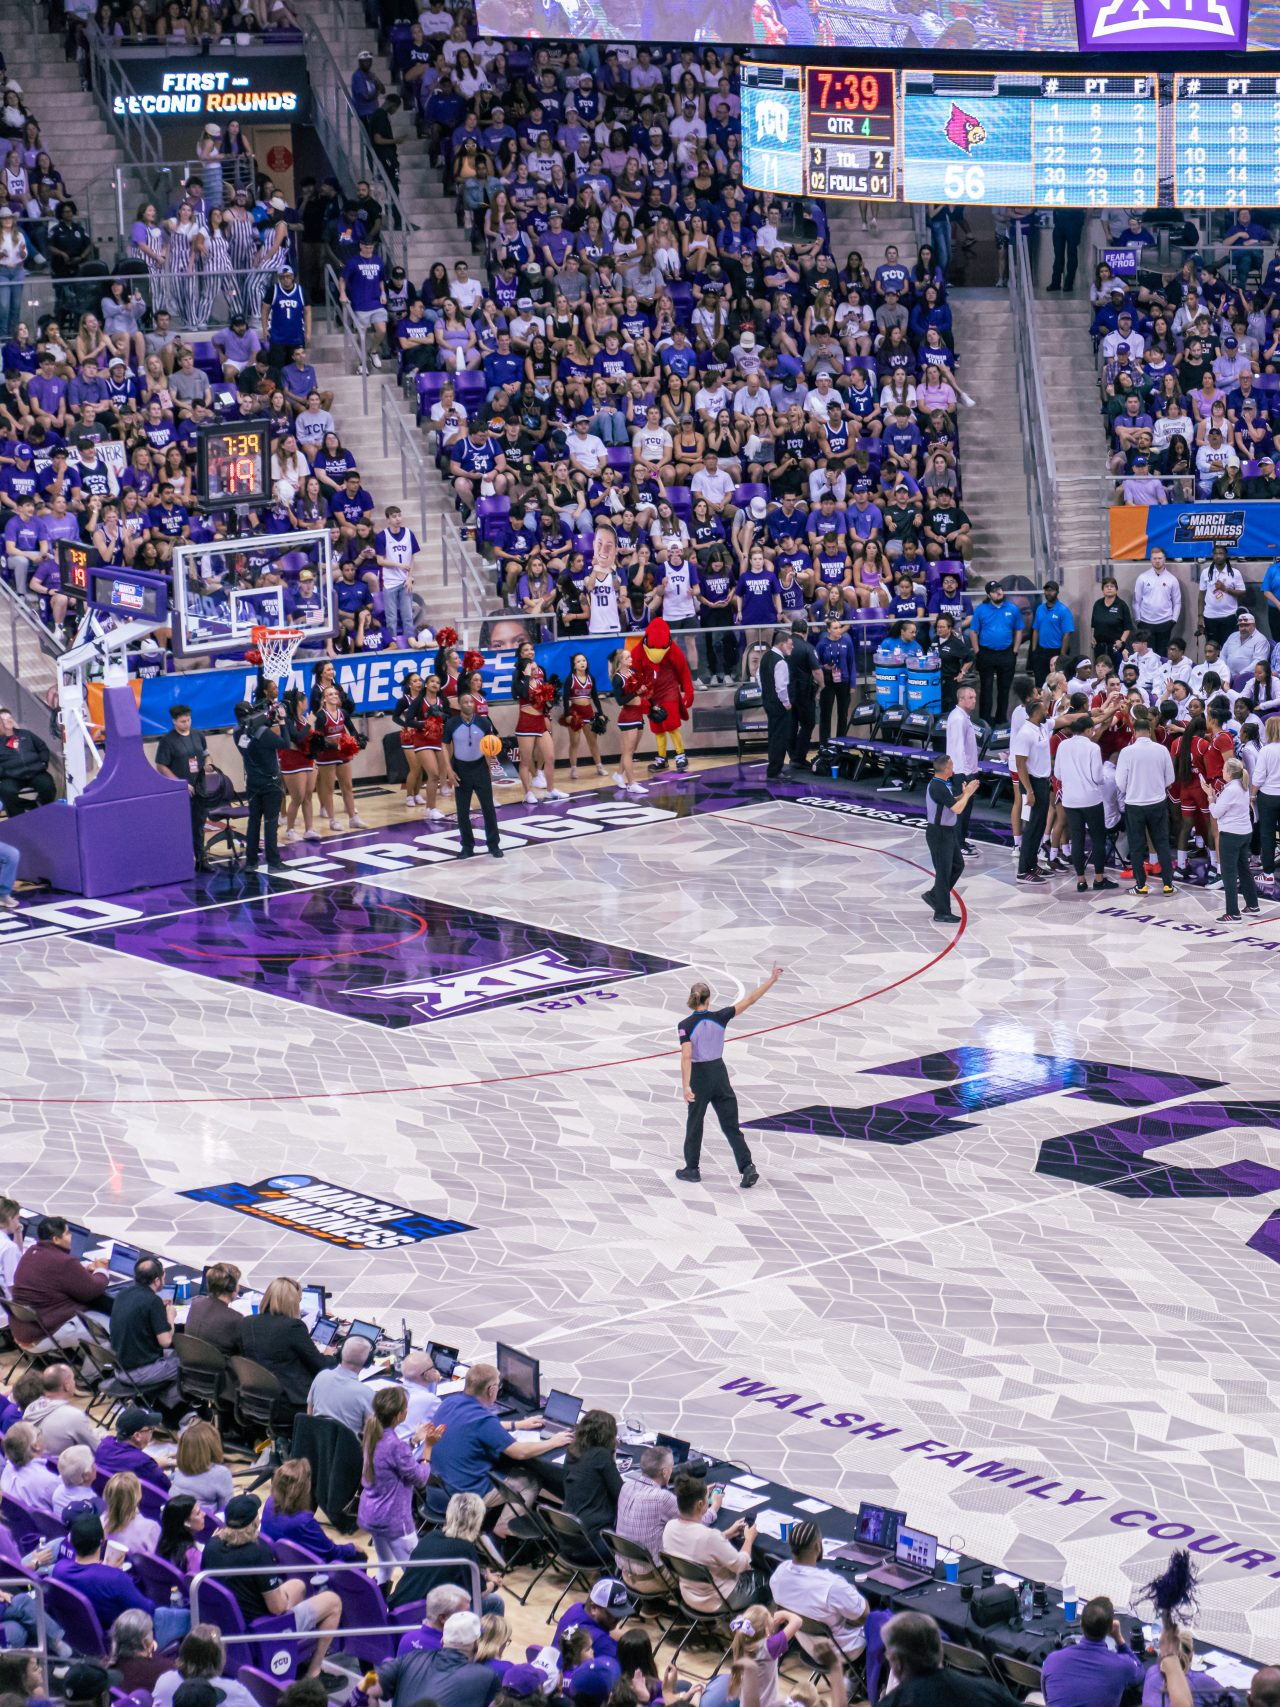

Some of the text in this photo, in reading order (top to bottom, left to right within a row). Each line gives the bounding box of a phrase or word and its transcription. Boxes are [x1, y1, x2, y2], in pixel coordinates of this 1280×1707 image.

[163, 72, 229, 91] FIRST
[1085, 79, 1108, 94] PT
[1227, 79, 1250, 94] PT
[818, 74, 879, 111] 7:39
[113, 92, 297, 114] SECOND ROUNDS
[1188, 103, 1200, 119] 2
[1231, 103, 1243, 119] 9
[1050, 103, 1145, 120] 1 8 2
[755, 99, 789, 143] TCU
[827, 117, 871, 136] QTR 4
[1046, 126, 1144, 143] 11 2 1
[1189, 127, 1201, 142] 4
[1228, 126, 1248, 142] 13
[813, 148, 884, 168] 3 TOL 2
[1043, 147, 1145, 164] 22 2 2
[1184, 148, 1206, 163] 10
[1228, 147, 1248, 163] 14
[762, 154, 778, 187] 71
[1043, 168, 1145, 184] 30 29 0
[1184, 167, 1206, 183] 13
[1228, 167, 1248, 183] 14
[811, 172, 887, 193] 02 FOULS 01
[944, 166, 986, 200] 56
[1043, 189, 1145, 206] 44 13 3
[1184, 190, 1205, 206] 21
[1226, 190, 1247, 206] 21
[1105, 253, 1125, 262] FEAR
[1112, 259, 1135, 269] FROG
[881, 270, 905, 281] TCU
[496, 289, 516, 299] TCU
[279, 300, 298, 308] TCU
[286, 308, 290, 319] 1
[304, 423, 328, 436] TCU
[223, 434, 259, 456] 7:39
[645, 437, 661, 445] TCU
[787, 439, 803, 449] TCU
[830, 439, 845, 447] TCU
[474, 459, 487, 470] 54
[83, 475, 107, 485] TCU
[229, 459, 254, 494] 19
[90, 484, 107, 494] 23
[1189, 514, 1226, 526] MARCH
[1194, 525, 1242, 537] MADNESS
[73, 568, 87, 588] 19
[706, 578, 730, 586] WINNER
[745, 579, 770, 587] WINNER
[592, 585, 611, 595] TCU
[709, 584, 727, 592] STAYS
[748, 585, 769, 593] STAYS
[783, 591, 796, 599] TCU
[597, 595, 608, 607] 10
[785, 599, 796, 607] 73
[896, 603, 915, 612] TCU
[254, 801, 678, 886] FROGS
[1097, 906, 1229, 938] WALSH
[516, 990, 620, 1014] 1873
[289, 1184, 414, 1222] MARCH
[250, 1199, 416, 1249] MADNESS
[718, 1376, 902, 1441] WALSH
[900, 1439, 1107, 1507] FAMILY
[272, 1656, 290, 1670] TCU
